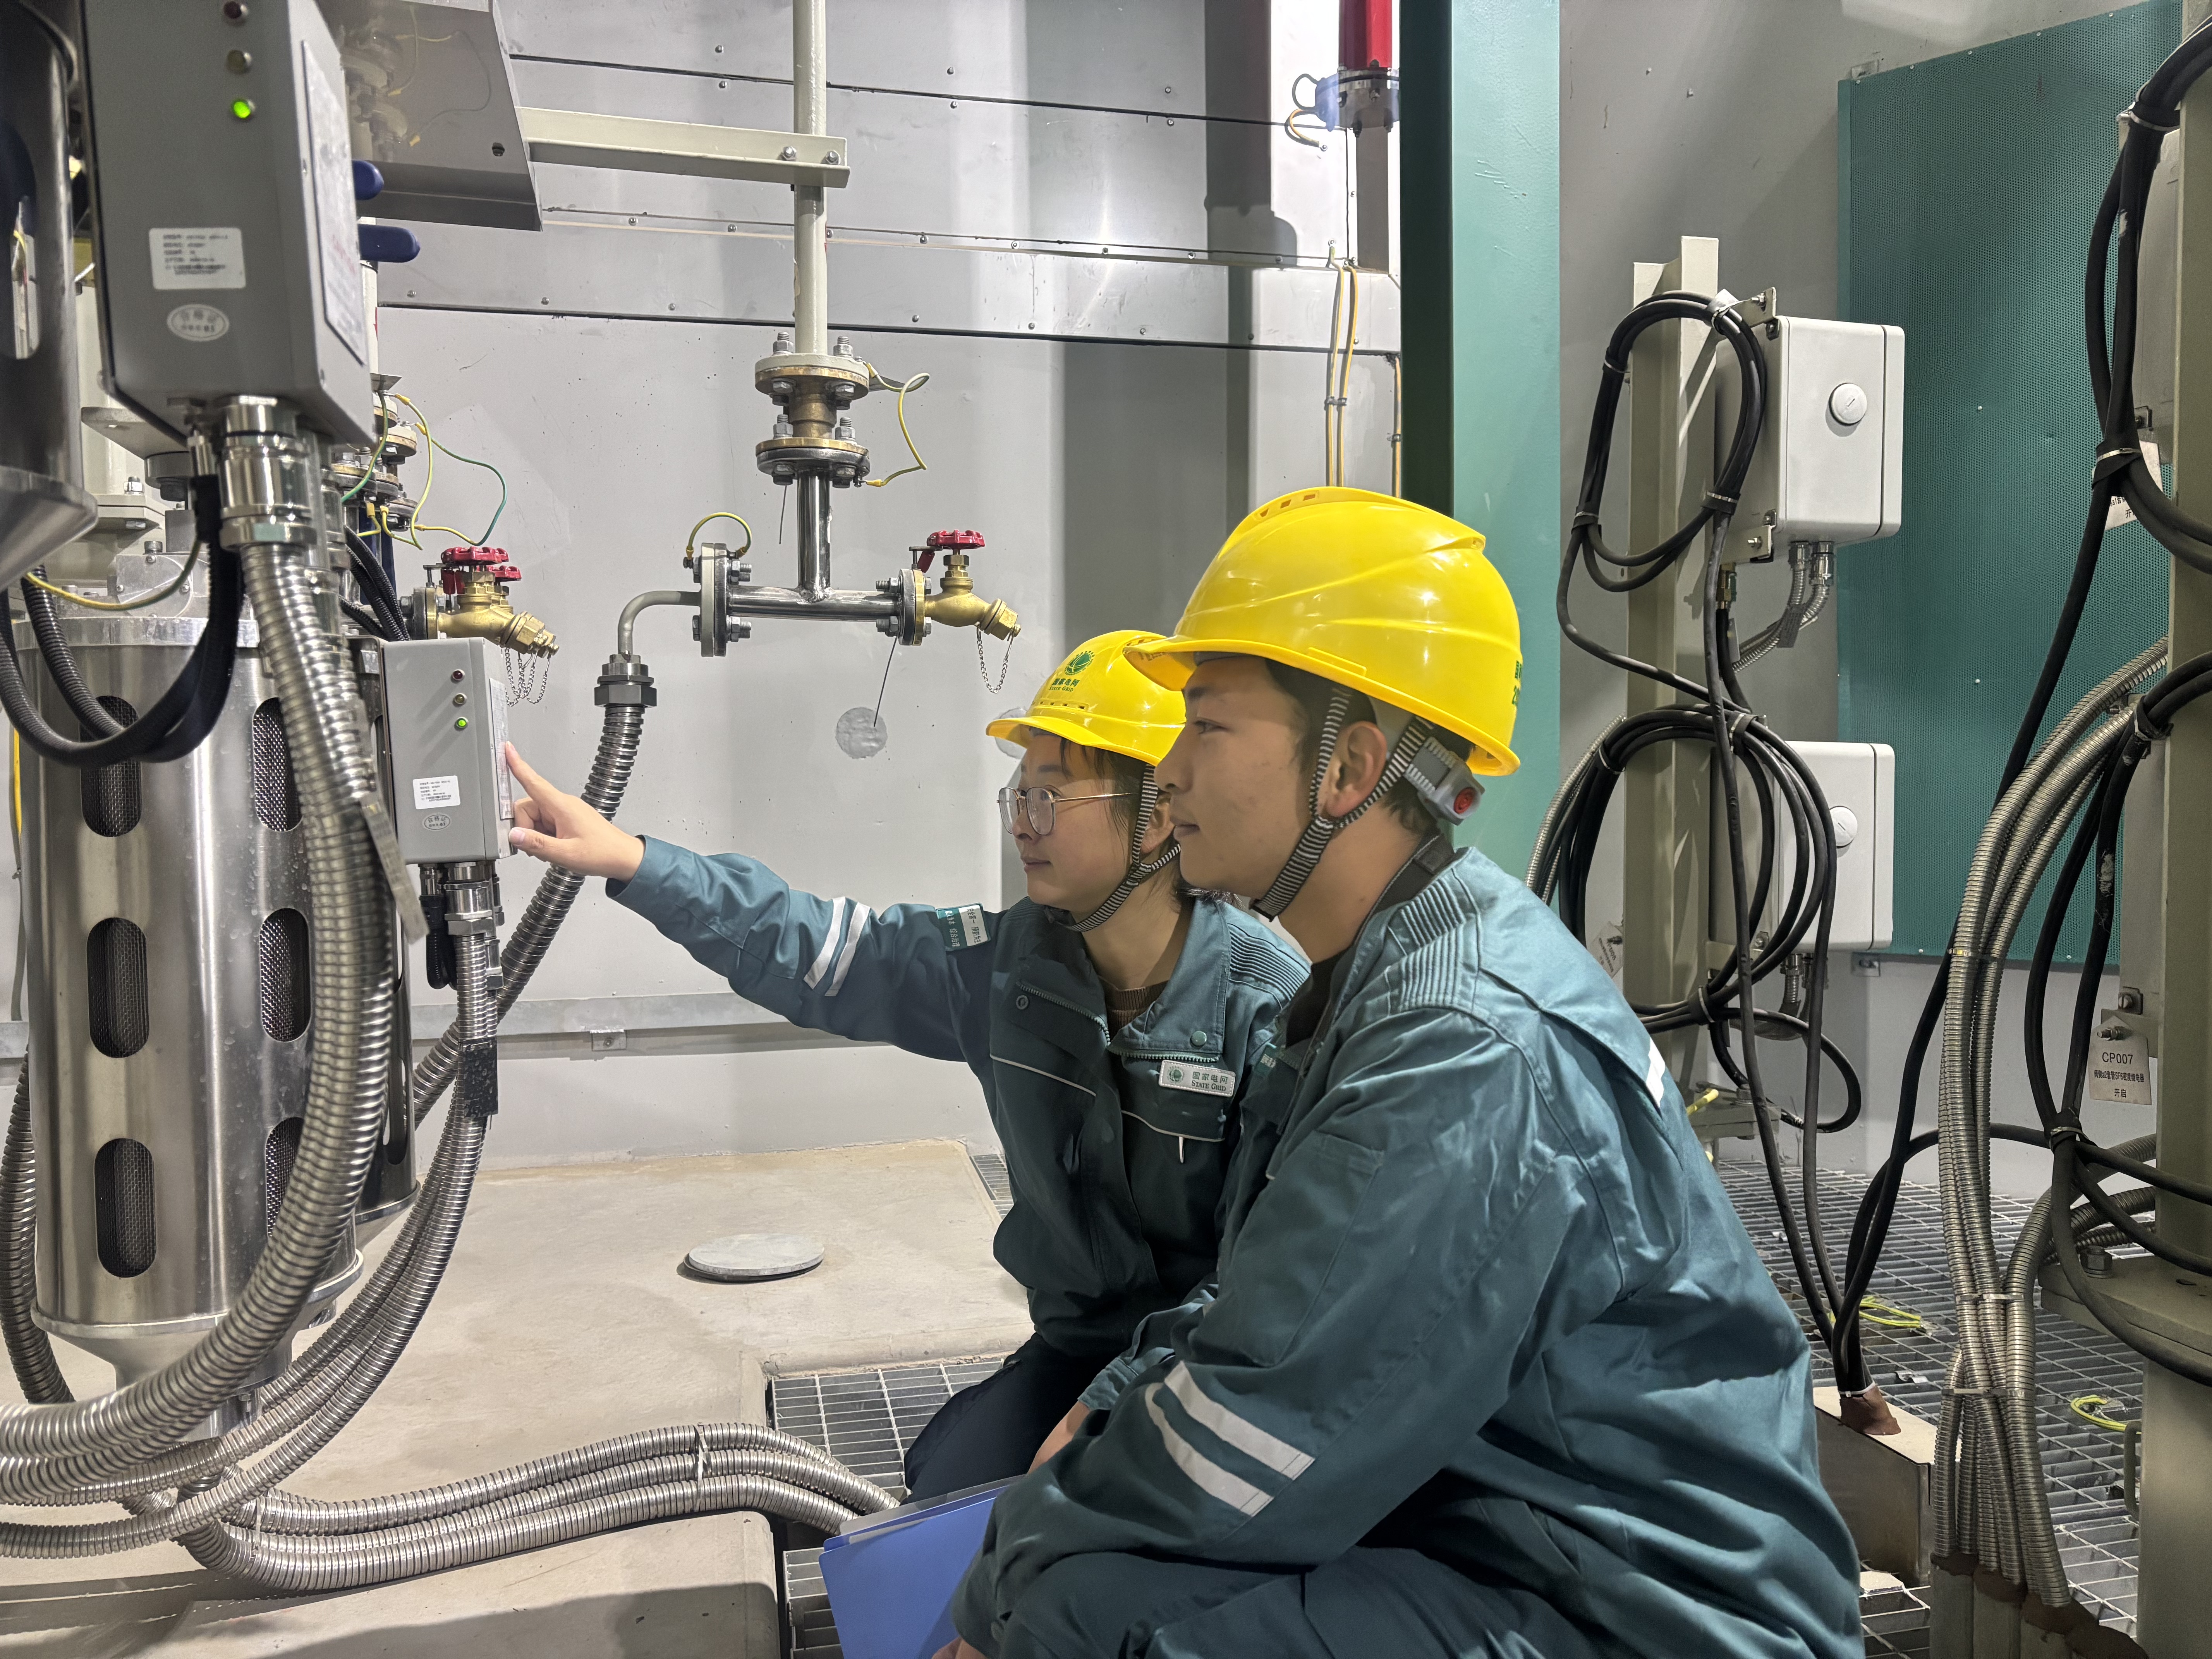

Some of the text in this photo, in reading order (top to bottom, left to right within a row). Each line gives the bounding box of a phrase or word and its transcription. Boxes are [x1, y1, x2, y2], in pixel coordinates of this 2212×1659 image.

[1051, 678, 1080, 687] 国家电网
[967, 908, 981, 943] 安全第一 预防为主
[949, 928, 960, 947] 综合治理
[2102, 1052, 2133, 1065] CP007
[1192, 1071, 1228, 1084] 国家电网
[1192, 1080, 1226, 1091] STATE GRID
[2114, 1088, 2126, 1097] 开启
